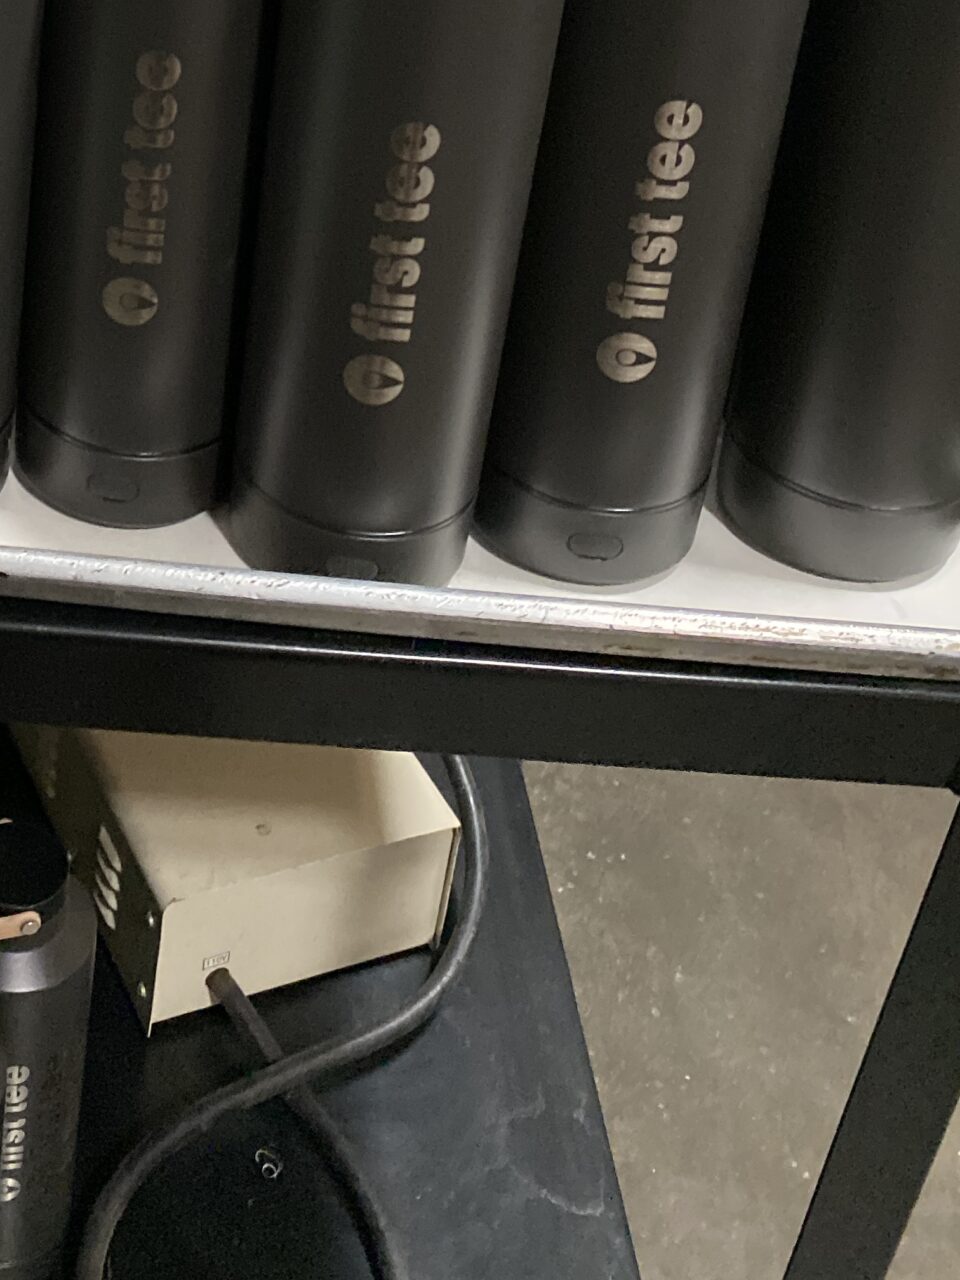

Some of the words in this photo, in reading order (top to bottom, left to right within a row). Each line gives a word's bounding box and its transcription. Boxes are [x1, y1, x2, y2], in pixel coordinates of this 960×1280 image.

[122, 48, 182, 149] tee
[635, 98, 704, 201] tee
[105, 161, 173, 265] first
[373, 120, 442, 222] tee
[349, 234, 426, 343] first
[605, 213, 685, 320] first
[4, 1065, 31, 1114] tee
